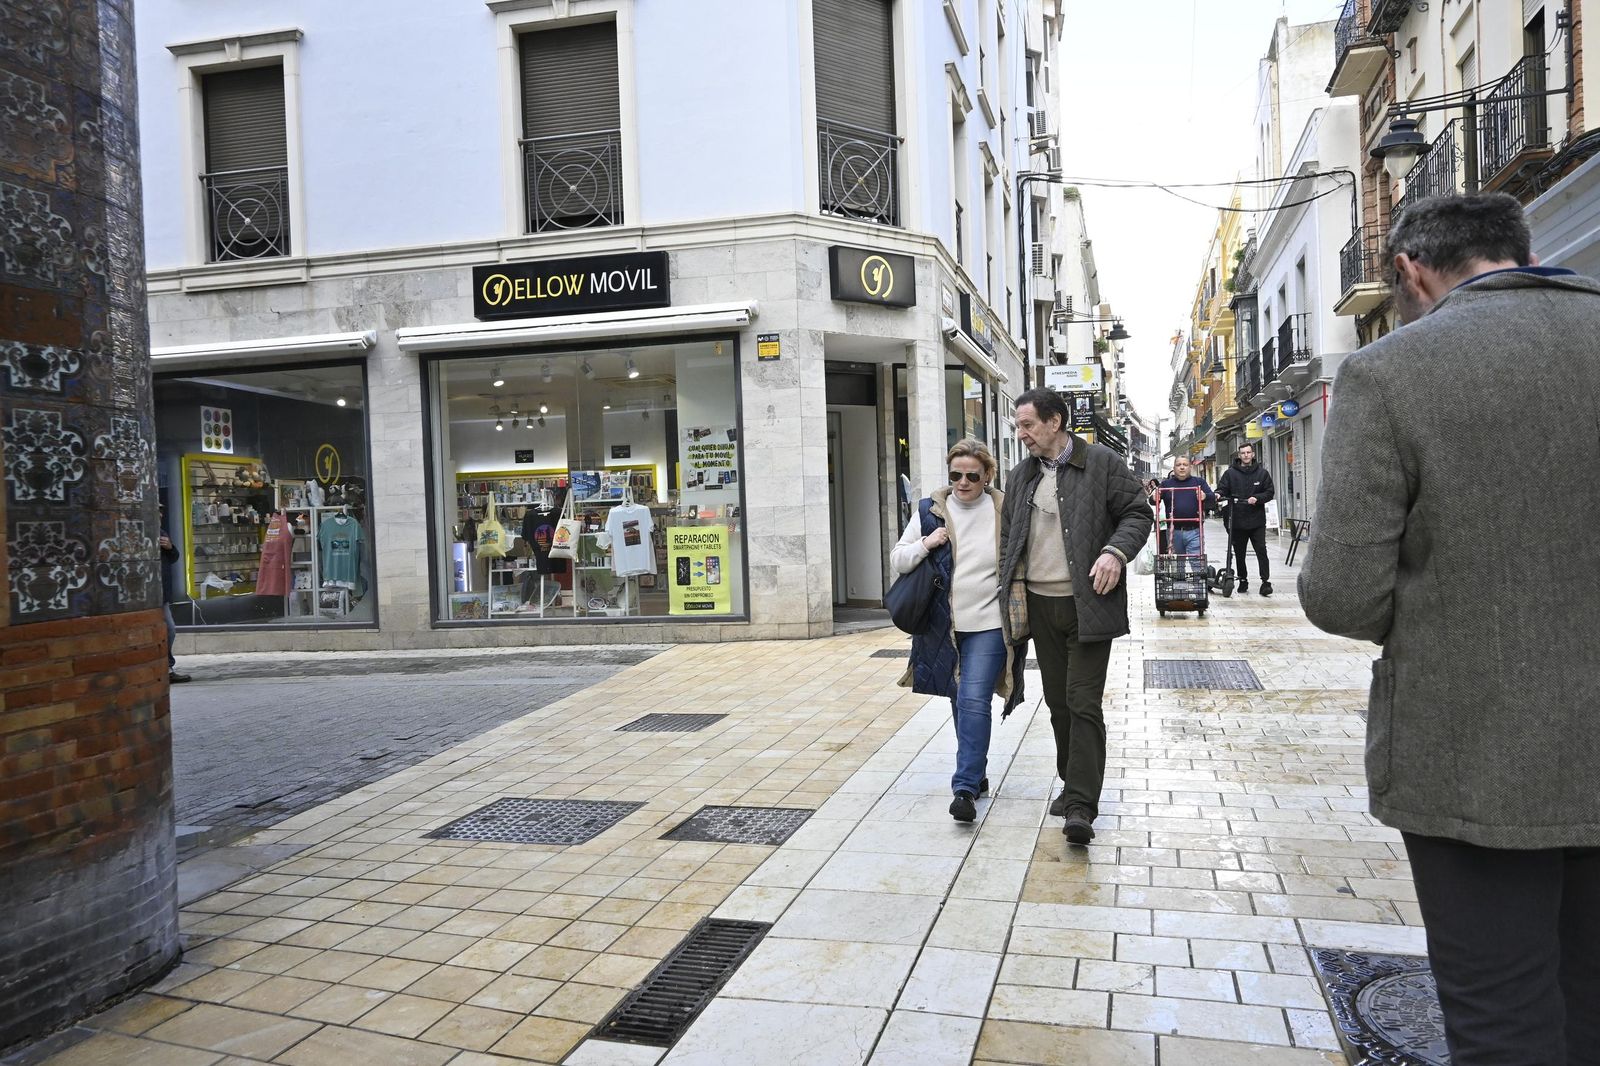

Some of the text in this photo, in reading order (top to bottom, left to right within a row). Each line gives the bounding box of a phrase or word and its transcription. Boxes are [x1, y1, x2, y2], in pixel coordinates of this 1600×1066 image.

[688, 442, 735, 452] CUALQUIER DIBUJO
[674, 533, 720, 544] REPARACION
